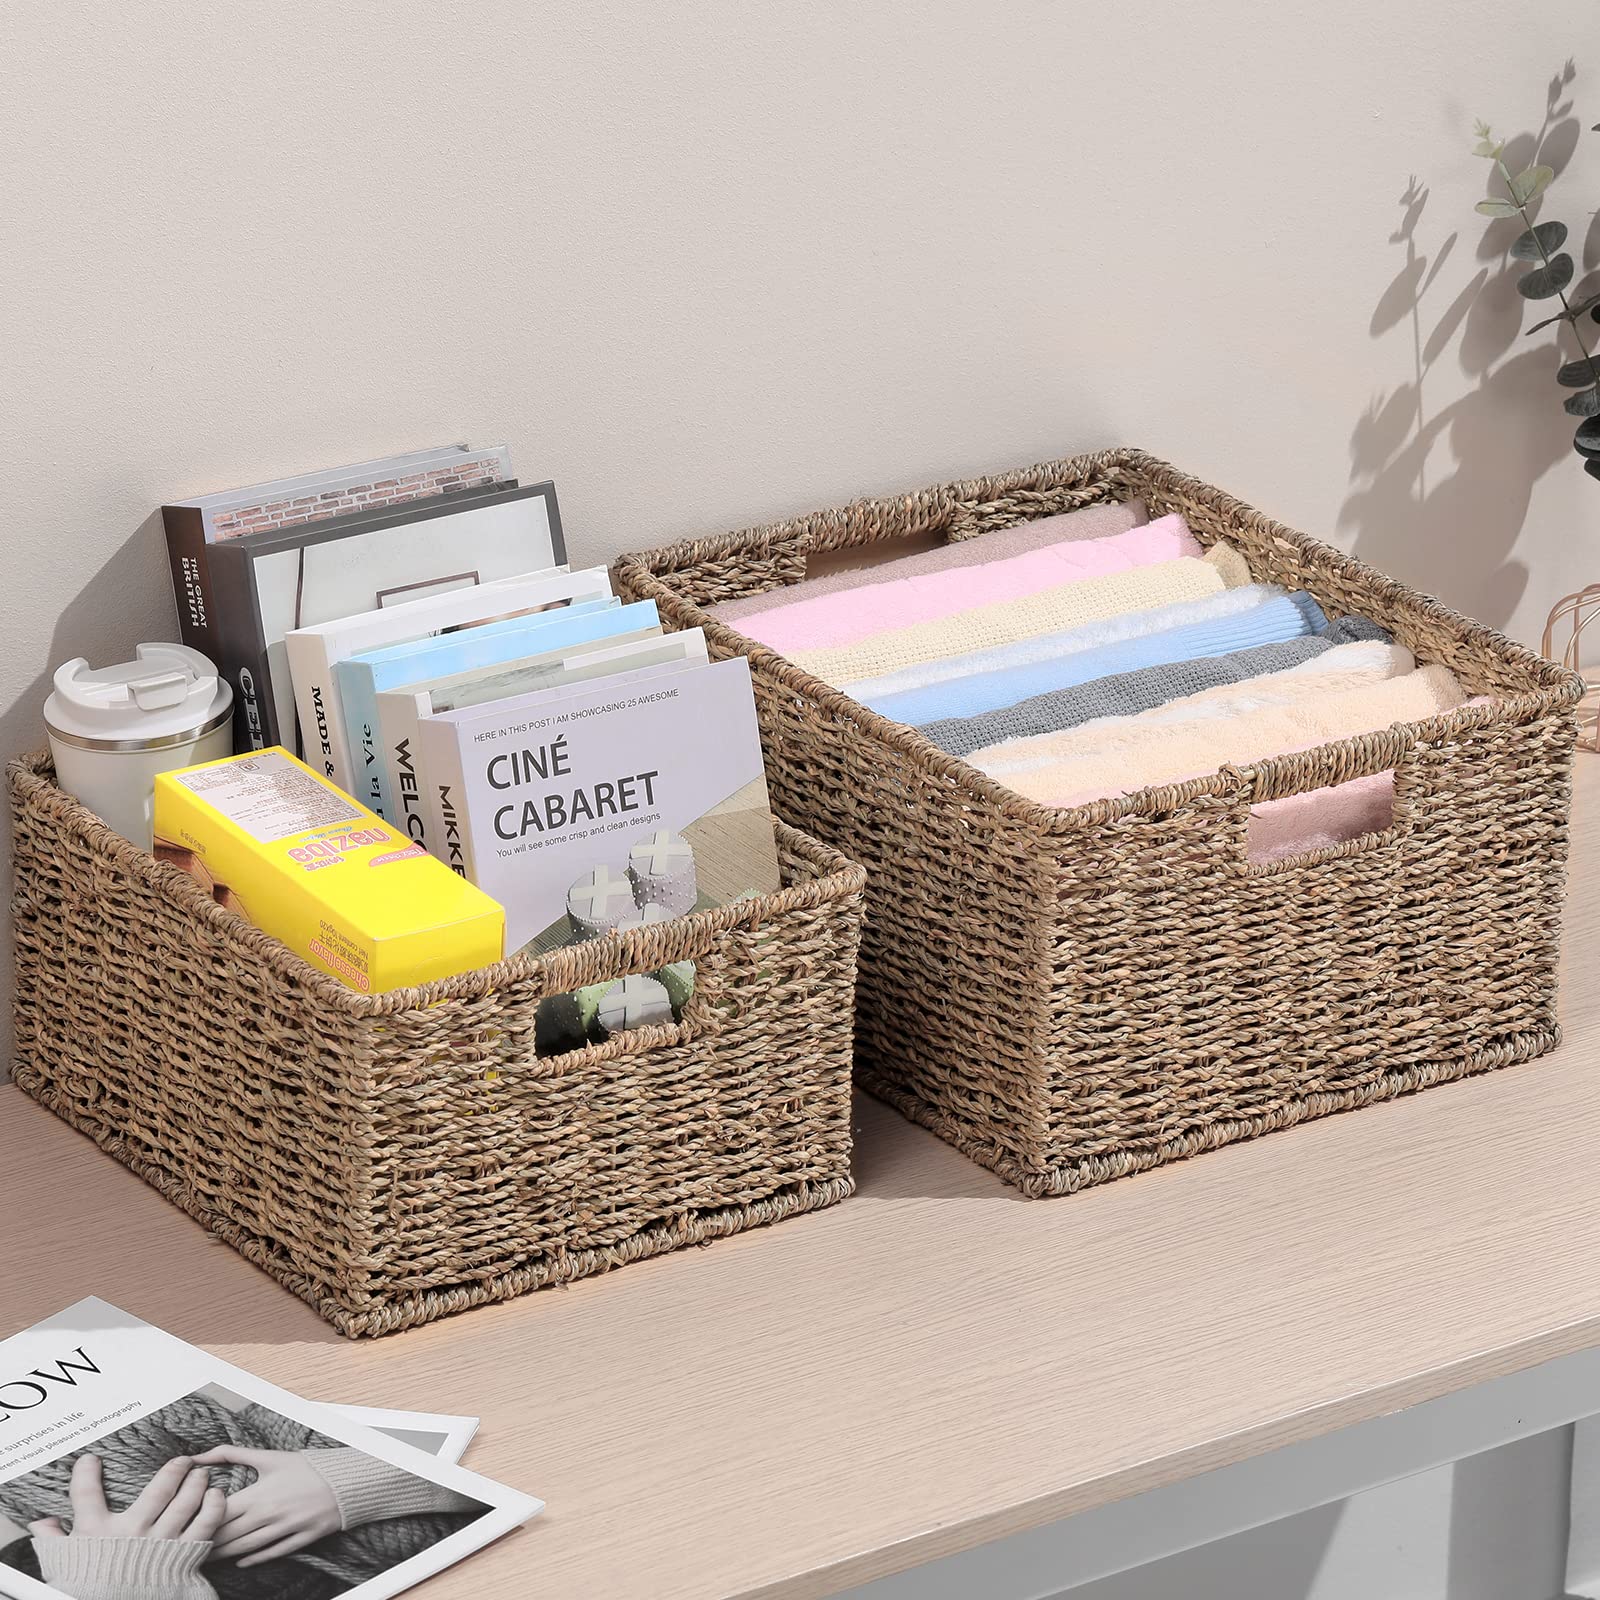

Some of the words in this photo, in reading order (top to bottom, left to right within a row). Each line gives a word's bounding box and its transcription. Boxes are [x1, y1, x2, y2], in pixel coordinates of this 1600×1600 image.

[182, 557, 199, 628] BRITISH
[190, 557, 200, 581] THE
[195, 584, 208, 628] GREAT
[312, 686, 332, 755] MADE
[325, 760, 335, 777] &
[474, 730, 497, 743] HERE
[498, 728, 507, 737] IN
[508, 723, 527, 735] THIS
[528, 718, 551, 731] POST
[556, 714, 569, 724] AM
[570, 701, 626, 721] SHOWCASING
[627, 699, 637, 708] 25
[637, 688, 680, 705] AWESOME
[362, 723, 376, 768] Vie
[486, 733, 572, 790] CINÉ
[493, 770, 659, 840] CABARET
[287, 826, 392, 864] naziba
[496, 846, 512, 858] You
[513, 843, 527, 855] will
[528, 841, 543, 851] see
[544, 834, 567, 848] some
[568, 829, 589, 843] crisp
[590, 825, 605, 837] and
[606, 819, 628, 833] clean
[629, 811, 661, 828] designs
[309, 937, 335, 969] flavor
[335, 956, 370, 993] Cheese
[0, 1345, 102, 1423] OW
[5, 1426, 55, 1452] surprises
[54, 1420, 66, 1429] in
[64, 1411, 86, 1423] life
[20, 1446, 46, 1461] visual
[45, 1430, 81, 1451] pleasure
[80, 1425, 91, 1433] to
[90, 1401, 142, 1429] photography
